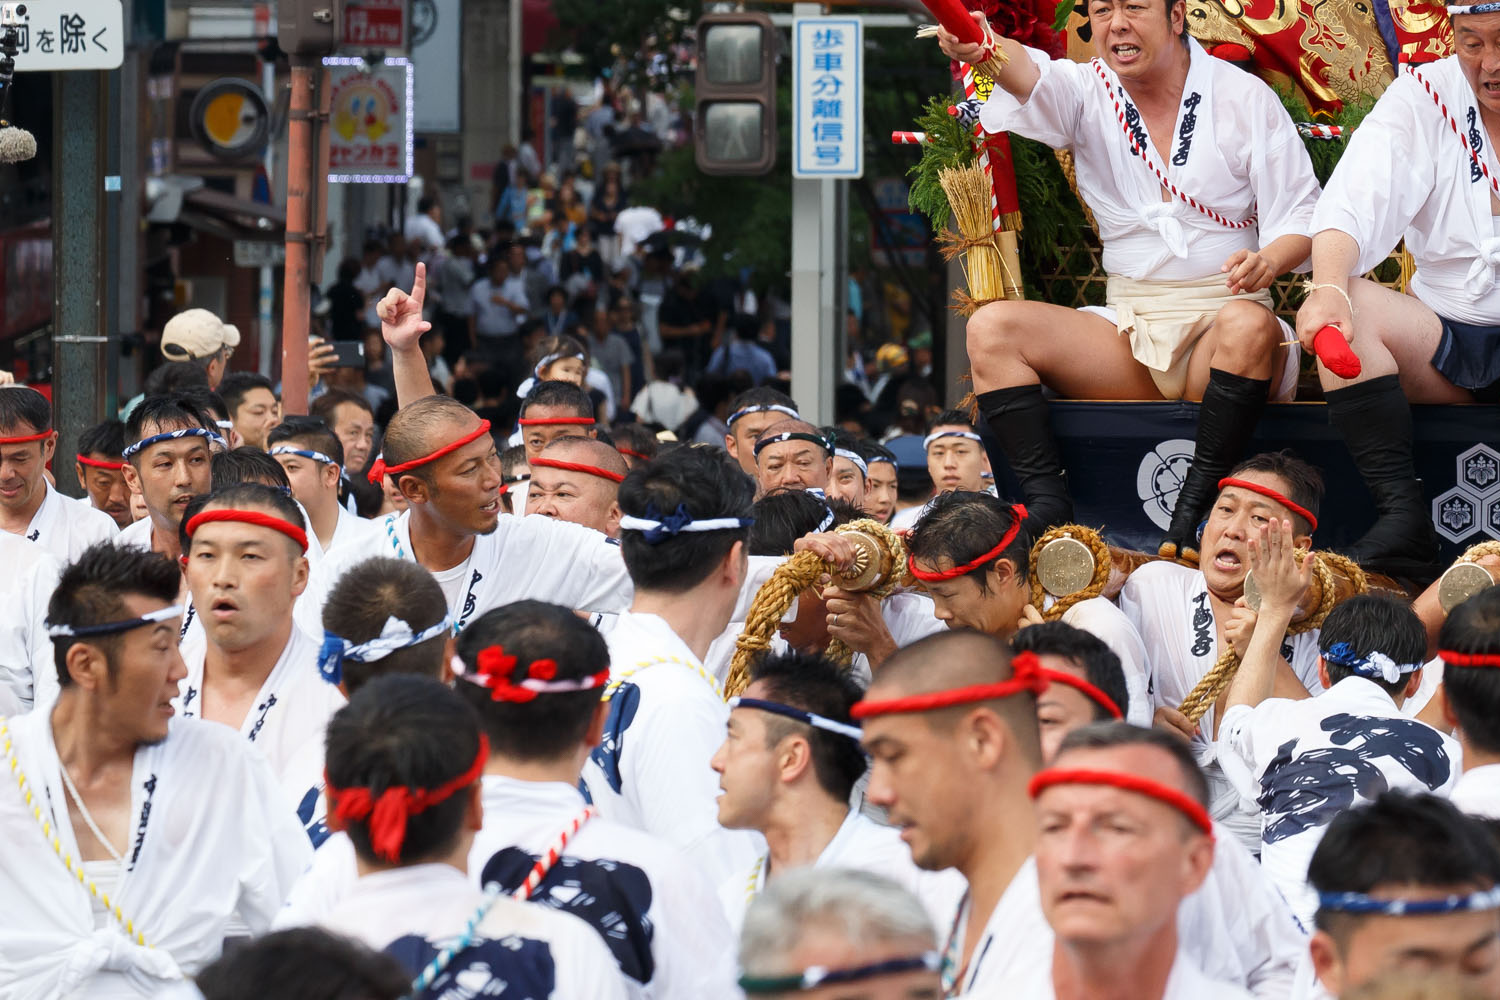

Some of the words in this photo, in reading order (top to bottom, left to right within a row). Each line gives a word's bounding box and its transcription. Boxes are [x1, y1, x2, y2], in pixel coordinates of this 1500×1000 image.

[812, 28, 844, 167] 歩車分離信号
